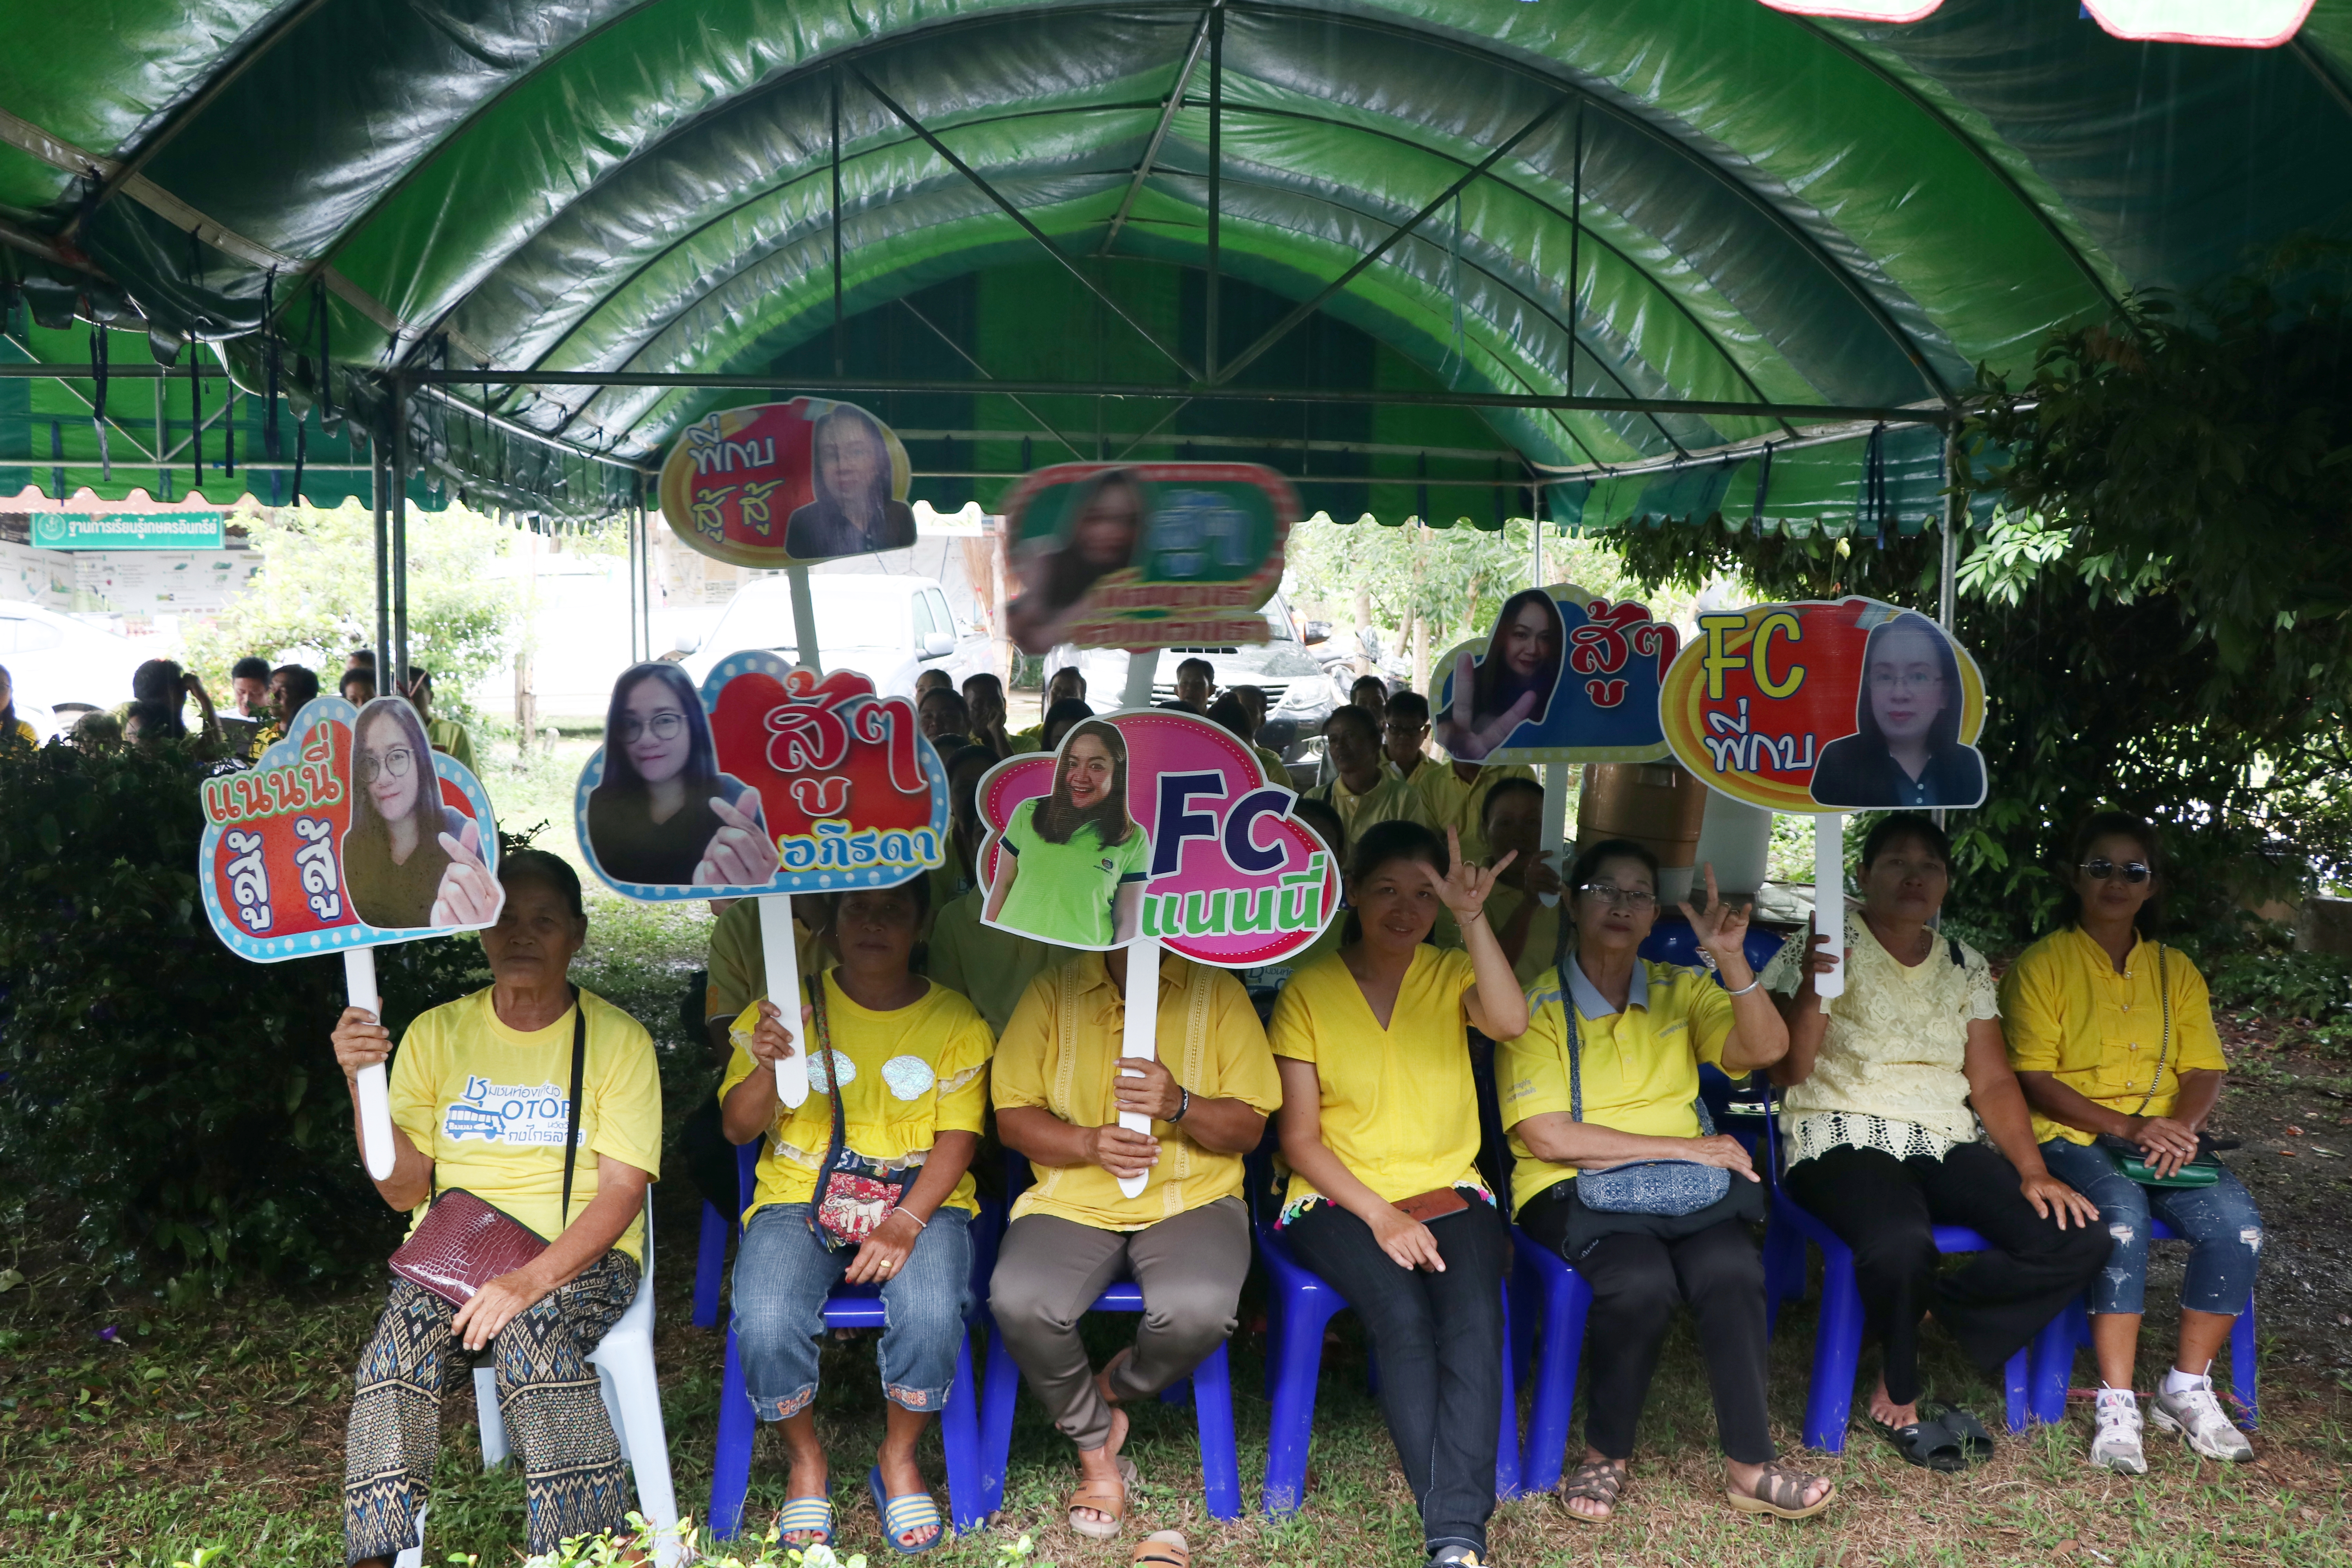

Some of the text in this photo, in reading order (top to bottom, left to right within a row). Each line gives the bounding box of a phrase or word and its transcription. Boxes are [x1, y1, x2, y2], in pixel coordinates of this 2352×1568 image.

[1699, 613, 1806, 699] FC
[207, 720, 342, 822] แนนนี่
[1704, 698, 1814, 772] พี่กบ
[783, 823, 938, 867] อภิรดา
[1149, 769, 1298, 878] FC
[227, 817, 341, 932] สู้ สู้
